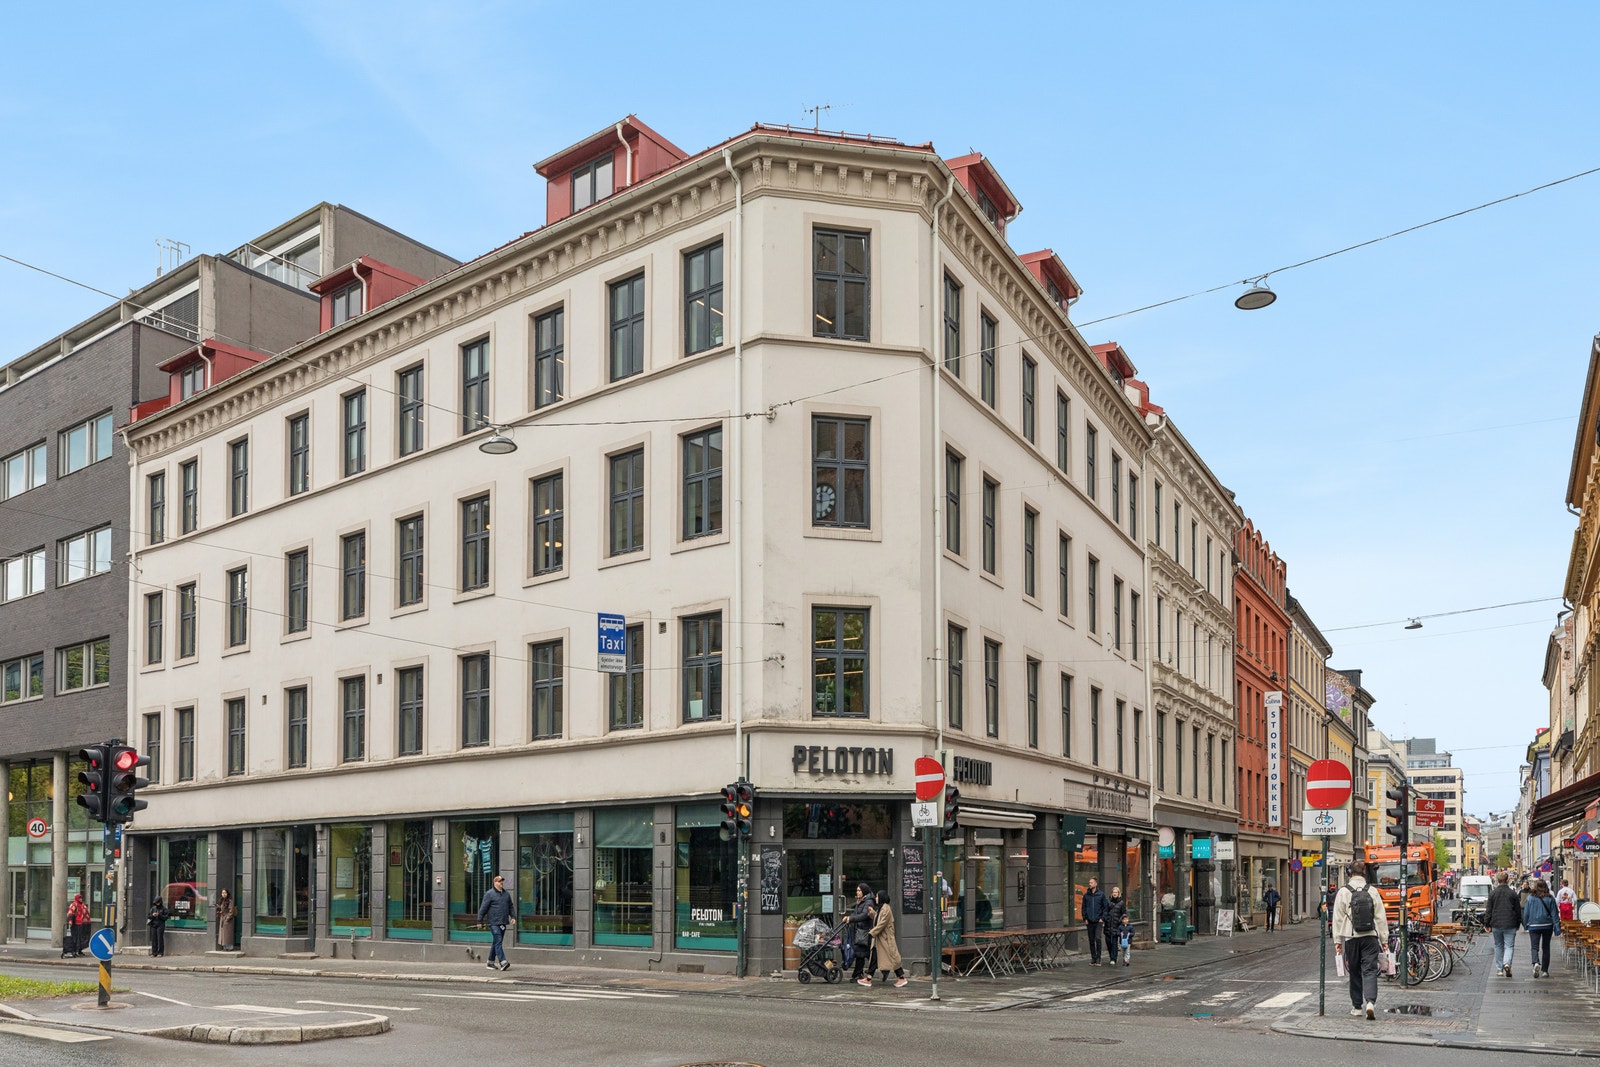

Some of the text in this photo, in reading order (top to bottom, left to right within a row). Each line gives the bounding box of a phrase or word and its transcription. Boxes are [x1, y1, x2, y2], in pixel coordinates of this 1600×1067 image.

[600, 635, 624, 650] Taxi
[792, 745, 894, 775] PELOTON
[954, 756, 992, 786] PELOTON
[30, 823, 44, 832] 40
[762, 894, 780, 907] PIZZA
[691, 908, 722, 921] PELOTON
